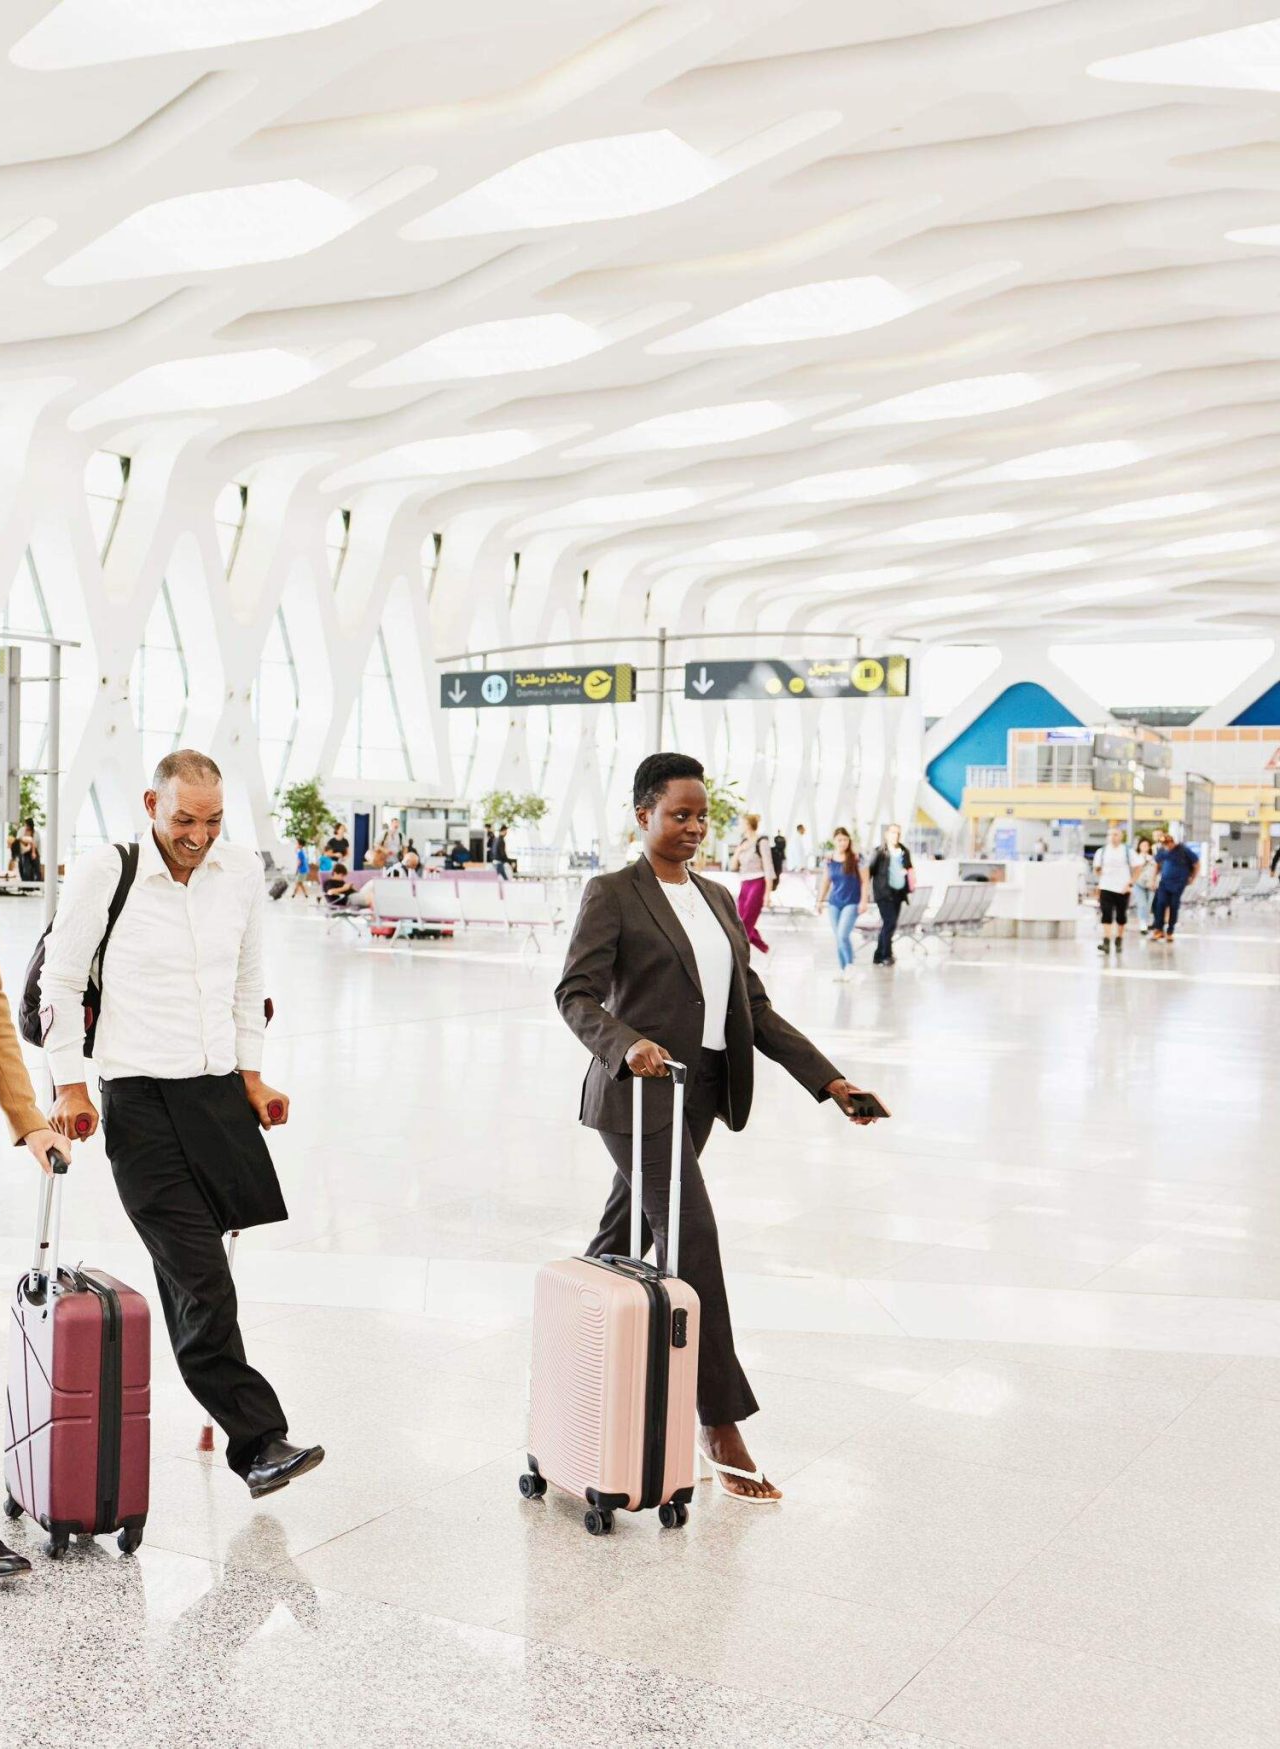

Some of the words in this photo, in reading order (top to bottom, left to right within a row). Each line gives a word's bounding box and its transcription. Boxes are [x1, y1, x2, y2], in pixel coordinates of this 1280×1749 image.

[515, 673, 546, 687] وطنية
[547, 671, 582, 685] رحلات
[516, 688, 552, 698] Domestic
